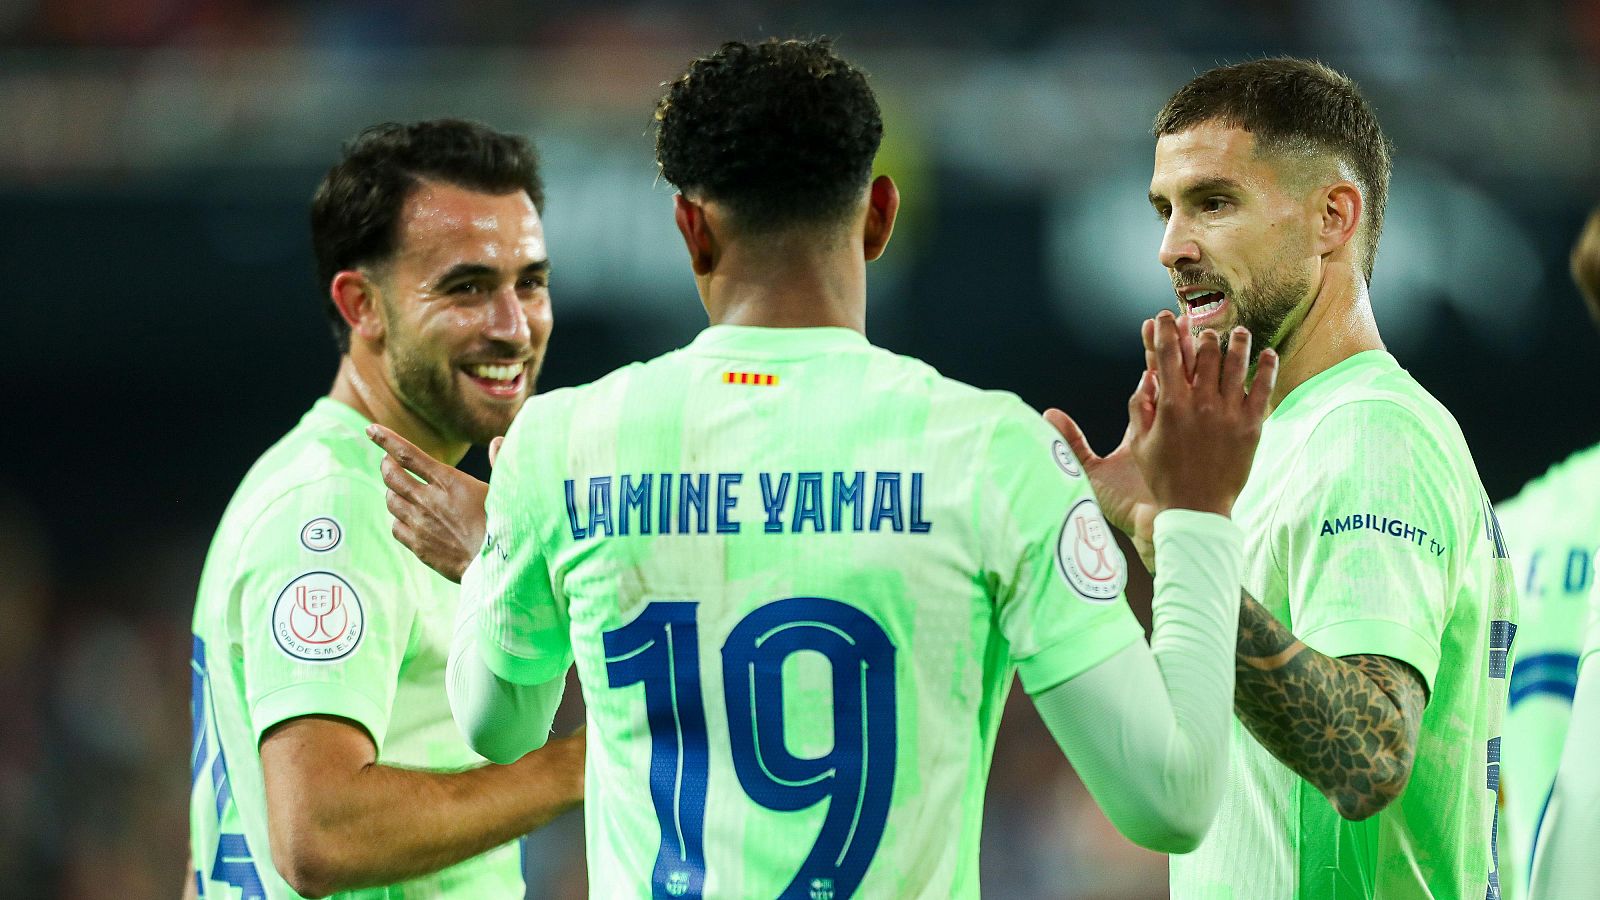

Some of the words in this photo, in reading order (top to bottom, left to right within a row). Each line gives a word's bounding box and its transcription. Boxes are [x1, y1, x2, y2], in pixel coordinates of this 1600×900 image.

[564, 473, 744, 541] LAMINE
[759, 471, 932, 533] YAMAL
[310, 528, 333, 540] 31
[1320, 514, 1428, 546] AMBILIGHT
[1429, 538, 1446, 557] tv
[279, 621, 296, 648] COPA
[296, 645, 311, 655] DE
[336, 640, 349, 652] EL
[346, 621, 358, 642] REY
[603, 597, 897, 900] 19
